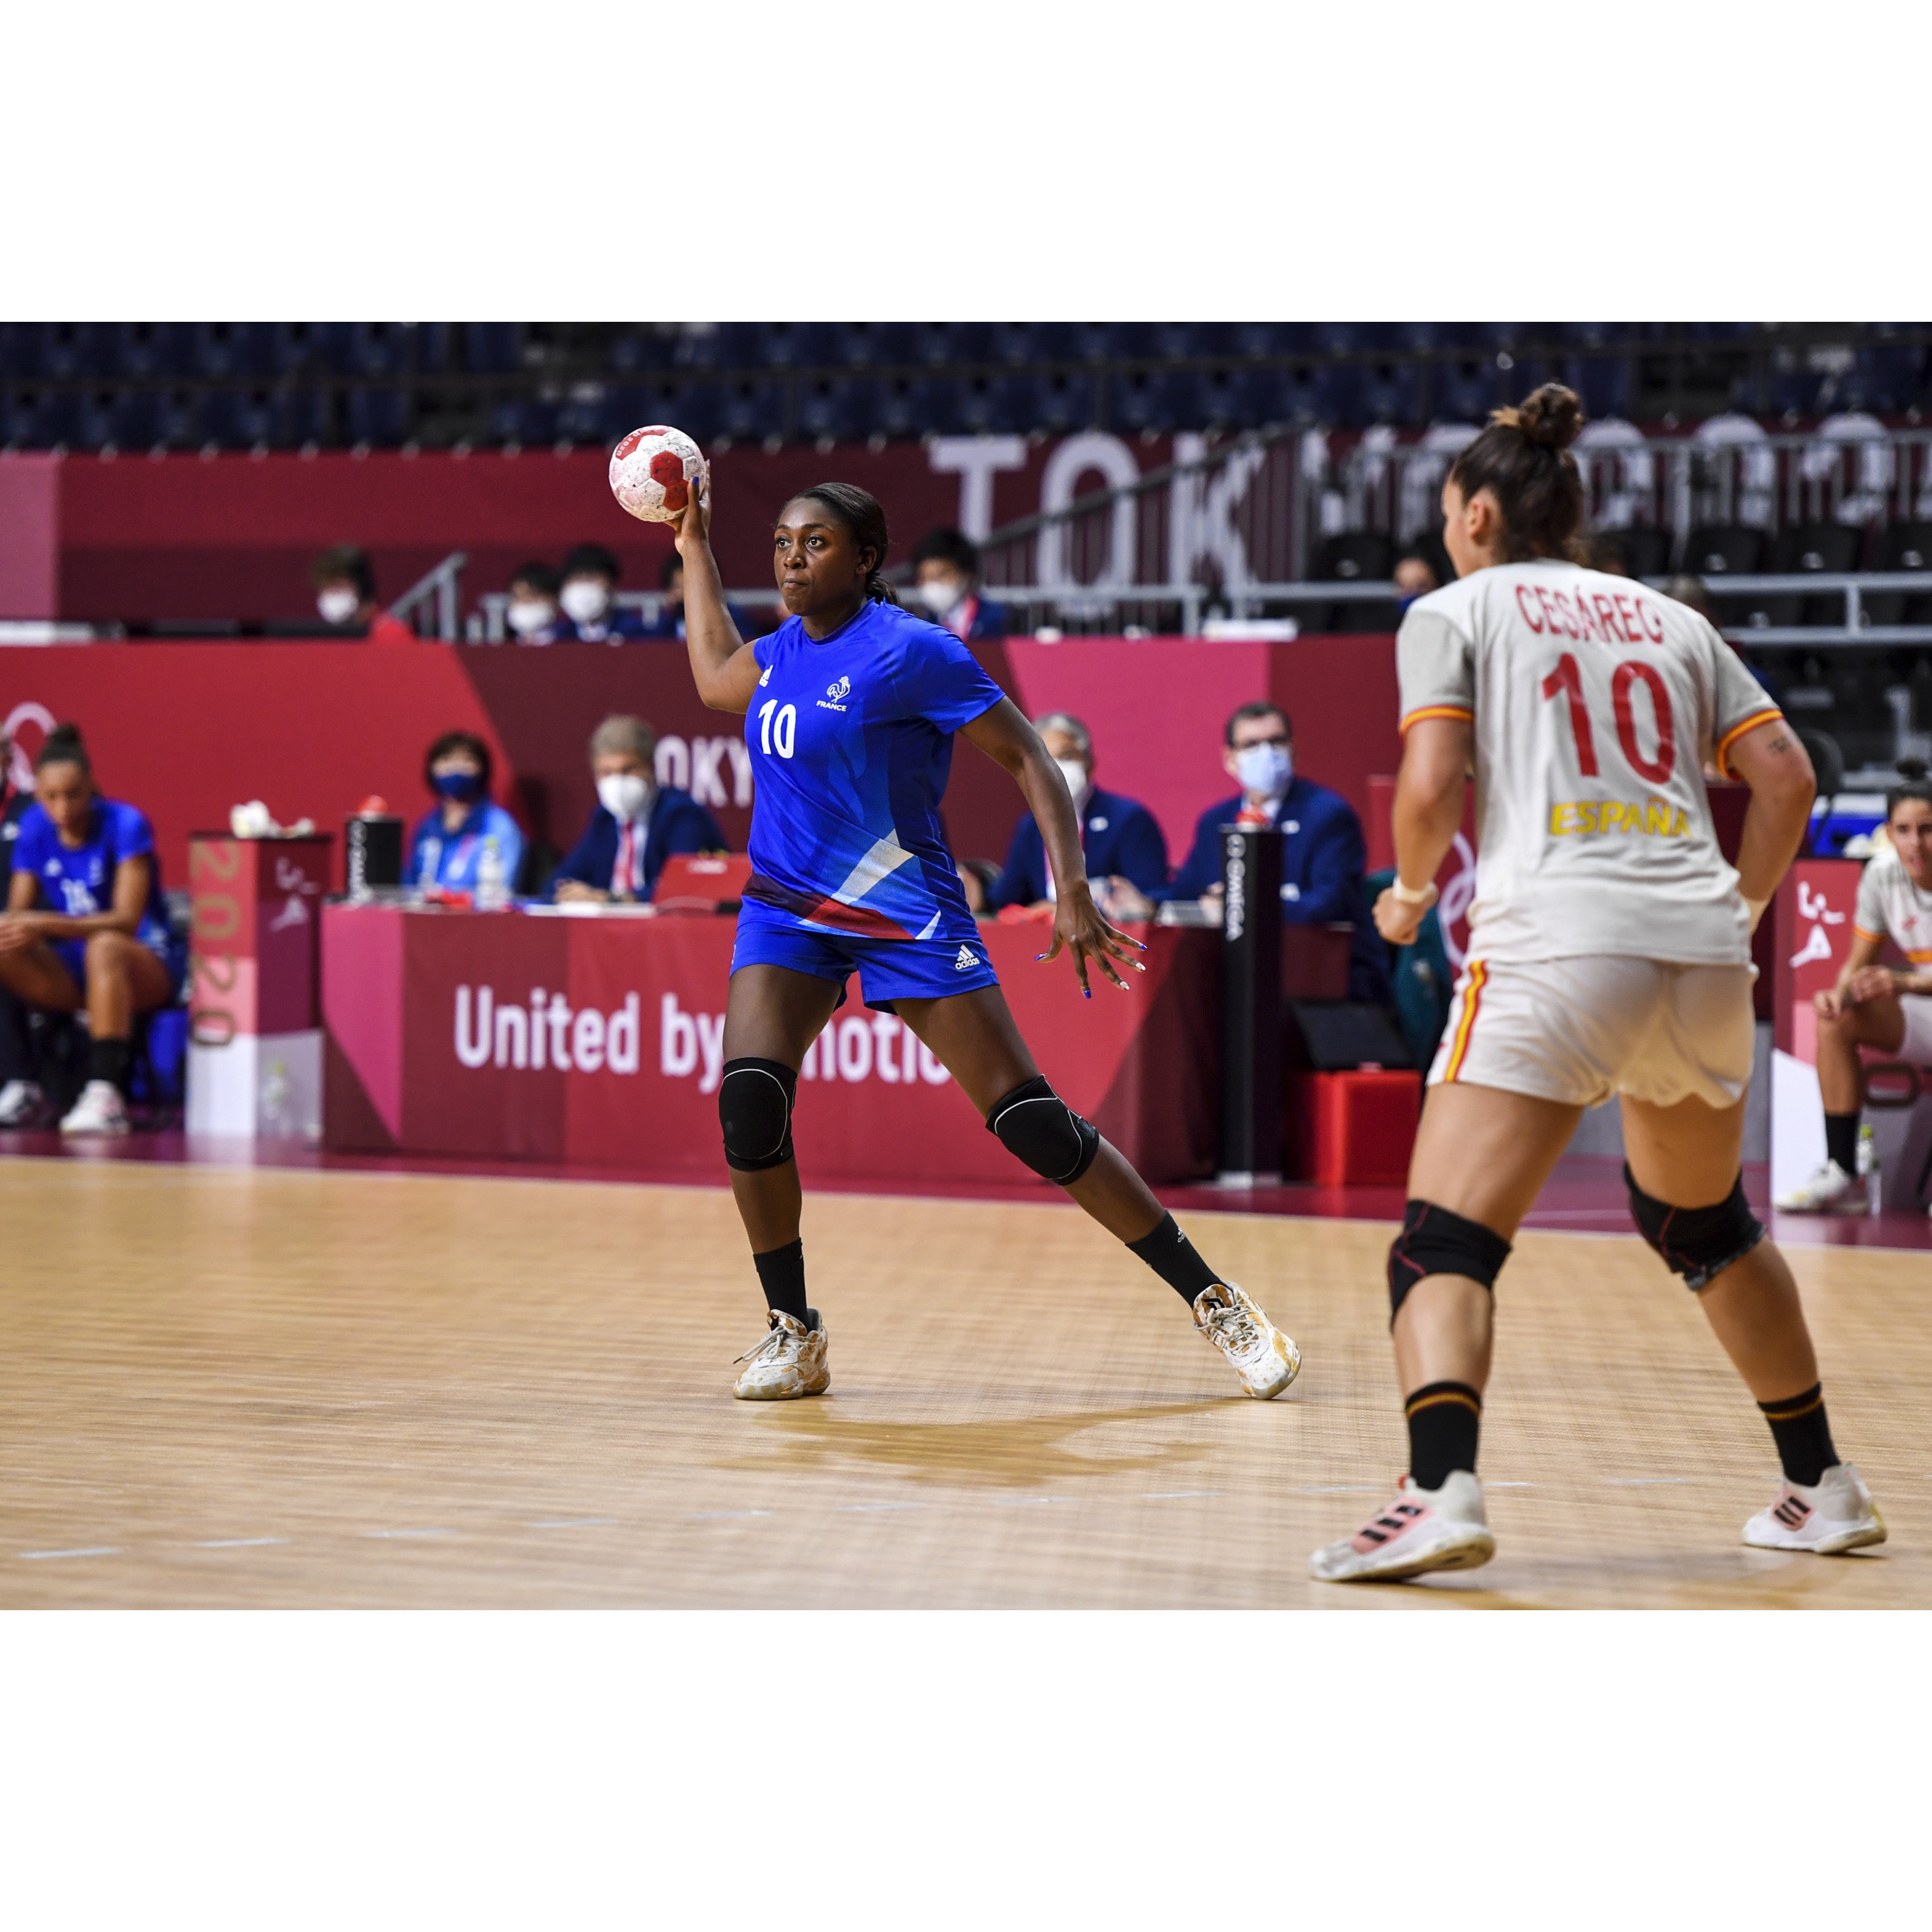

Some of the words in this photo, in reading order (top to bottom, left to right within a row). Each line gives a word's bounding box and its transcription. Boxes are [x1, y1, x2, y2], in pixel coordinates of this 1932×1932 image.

[758, 699, 796, 759] 10
[816, 700, 847, 712] FRANCE
[1542, 653, 1675, 785] 10
[654, 734, 753, 808] OKY
[1550, 796, 1692, 838] ESPAÑA
[955, 958, 980, 970] adidas
[454, 984, 641, 1076] United
[661, 991, 724, 1095] by
